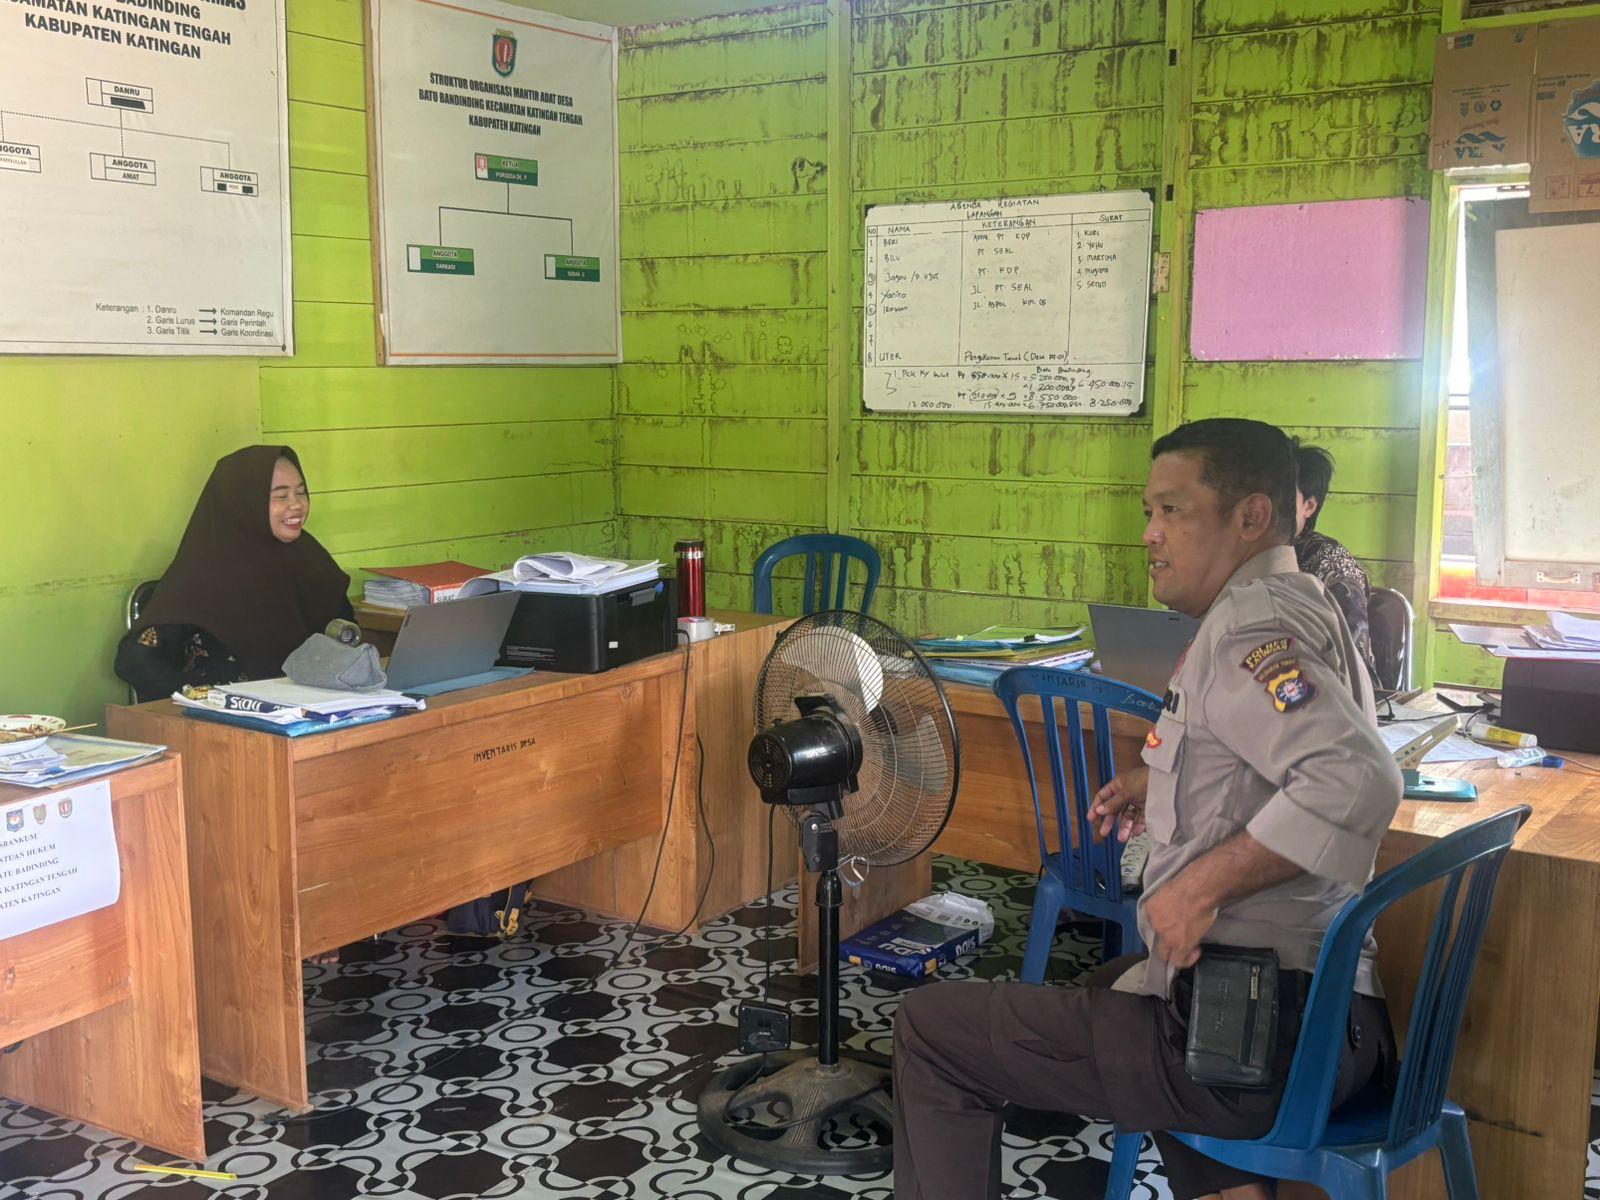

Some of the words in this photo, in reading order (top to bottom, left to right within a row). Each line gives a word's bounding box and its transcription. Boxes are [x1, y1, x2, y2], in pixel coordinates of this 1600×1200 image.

[93, 5, 170, 33] KATINGAN
[174, 21, 231, 45] TENGAH
[25, 13, 122, 44] KABUPATEN
[126, 32, 201, 59] KATINGAN
[114, 86, 141, 96] DANRU
[430, 72, 468, 90] STRUKTUR
[469, 80, 512, 97] ORGANISASI
[513, 87, 539, 101] MANTIR
[540, 91, 557, 104] ADAT
[557, 94, 573, 107] DESA
[419, 88, 438, 102] BATU
[486, 100, 526, 117] KECAMATAN
[526, 106, 559, 122] KATINGAN
[559, 112, 583, 126] TENGAH
[469, 114, 508, 131] KABUPATEN
[509, 121, 541, 136] KATINGAN
[112, 159, 148, 169] ANGGOTA
[122, 172, 140, 180] AMAT
[219, 172, 252, 182] ANGGOTA
[888, 226, 911, 235] NAMA
[981, 216, 1036, 229] KETERANGAN
[1099, 213, 1123, 221] SURAT
[432, 249, 459, 258] ANGGOTA
[1011, 283, 1033, 293] SEAL
[95, 303, 139, 314] Keterangan
[155, 305, 177, 313] Danru
[220, 308, 255, 317] Komandan
[257, 309, 274, 319] Regu
[155, 316, 174, 325] Garis
[176, 317, 196, 325] Lurus
[220, 318, 238, 326] Garis
[240, 319, 267, 328] Perintah
[155, 327, 175, 335] Garis
[176, 327, 191, 335] Titik
[221, 328, 239, 336] Garis
[240, 329, 274, 338] Koordinasi
[473, 742, 517, 763] INVENTARIS
[27, 843, 56, 857] HUKUM
[15, 858, 59, 875] BADINDING
[4, 876, 45, 893] KATINGAN
[47, 867, 78, 882] TENGAH
[21, 887, 61, 904] KATINGAN
